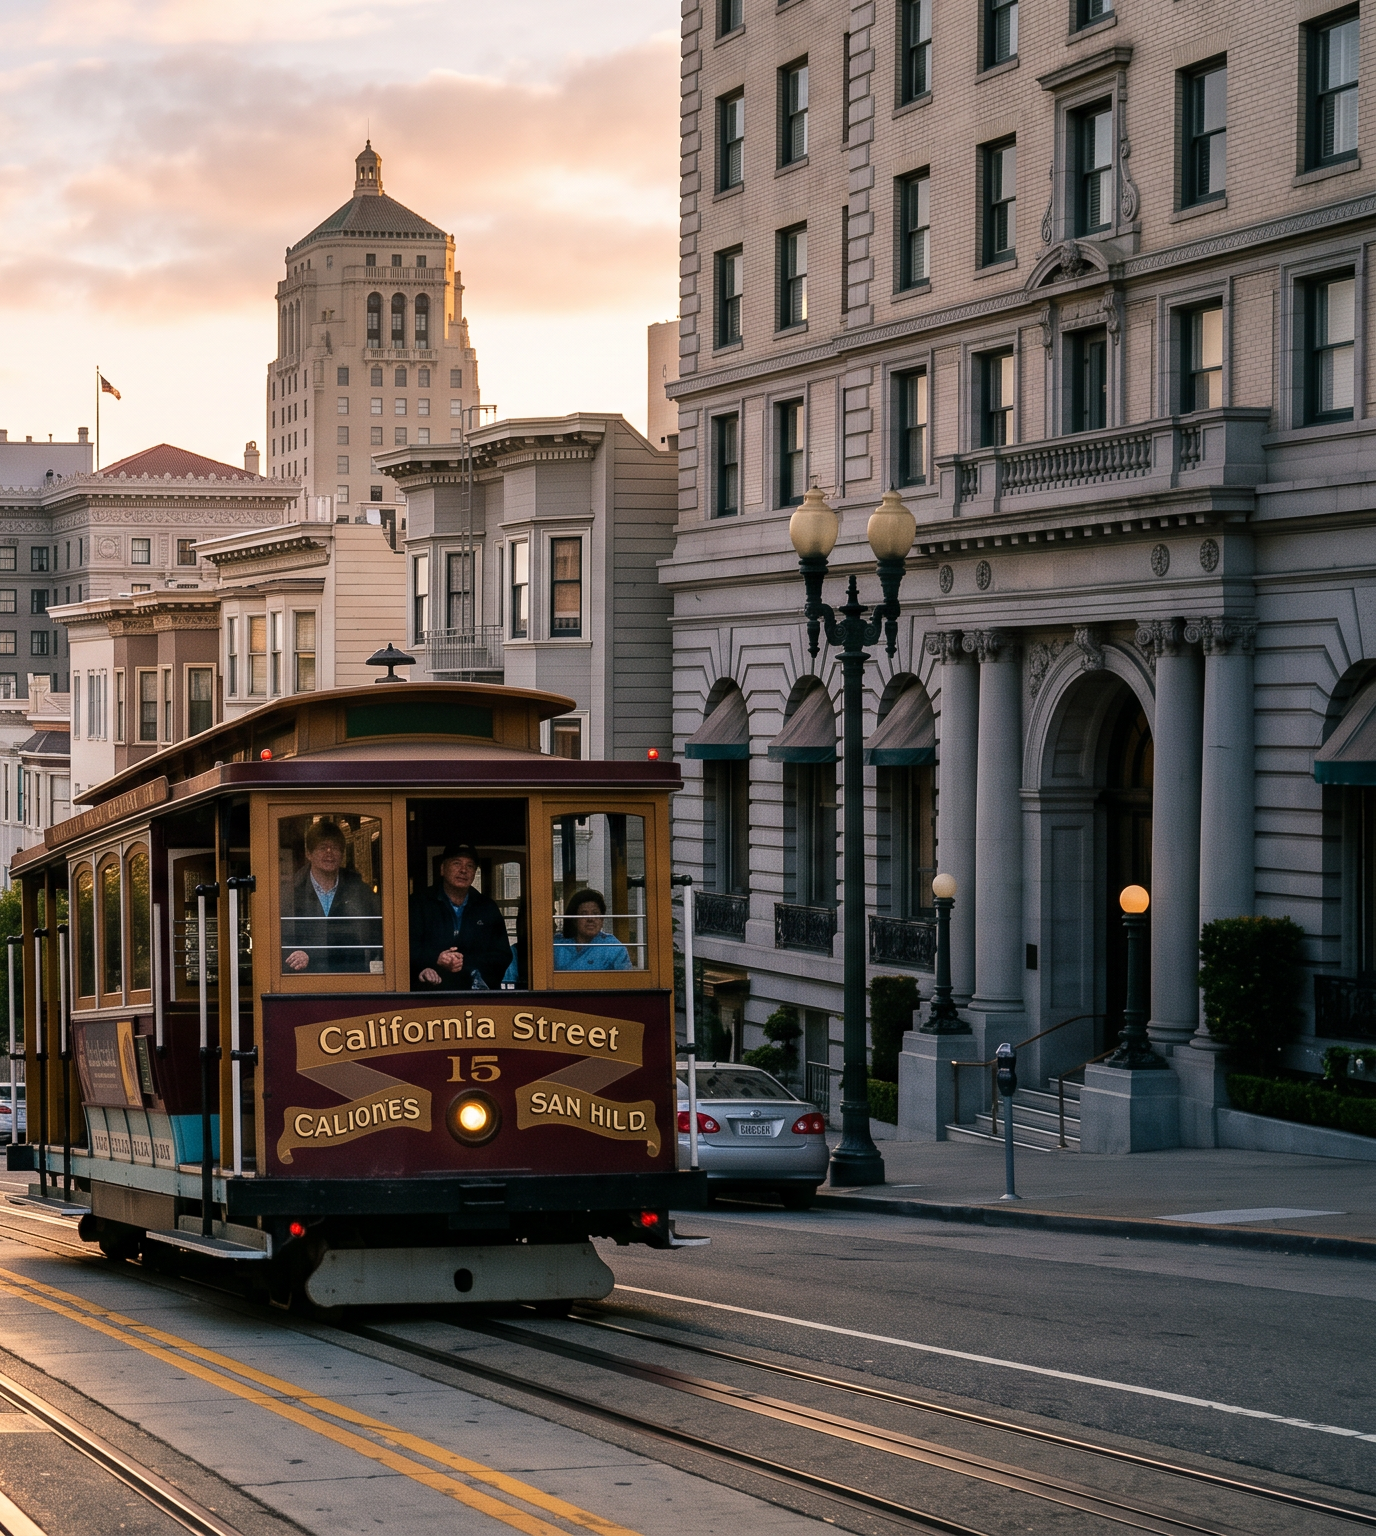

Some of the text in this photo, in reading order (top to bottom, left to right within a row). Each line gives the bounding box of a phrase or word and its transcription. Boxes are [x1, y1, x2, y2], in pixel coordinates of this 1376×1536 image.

[318, 1010, 619, 1055] California Street
[446, 1055, 502, 1082] 15
[530, 1092, 581, 1119] SAN
